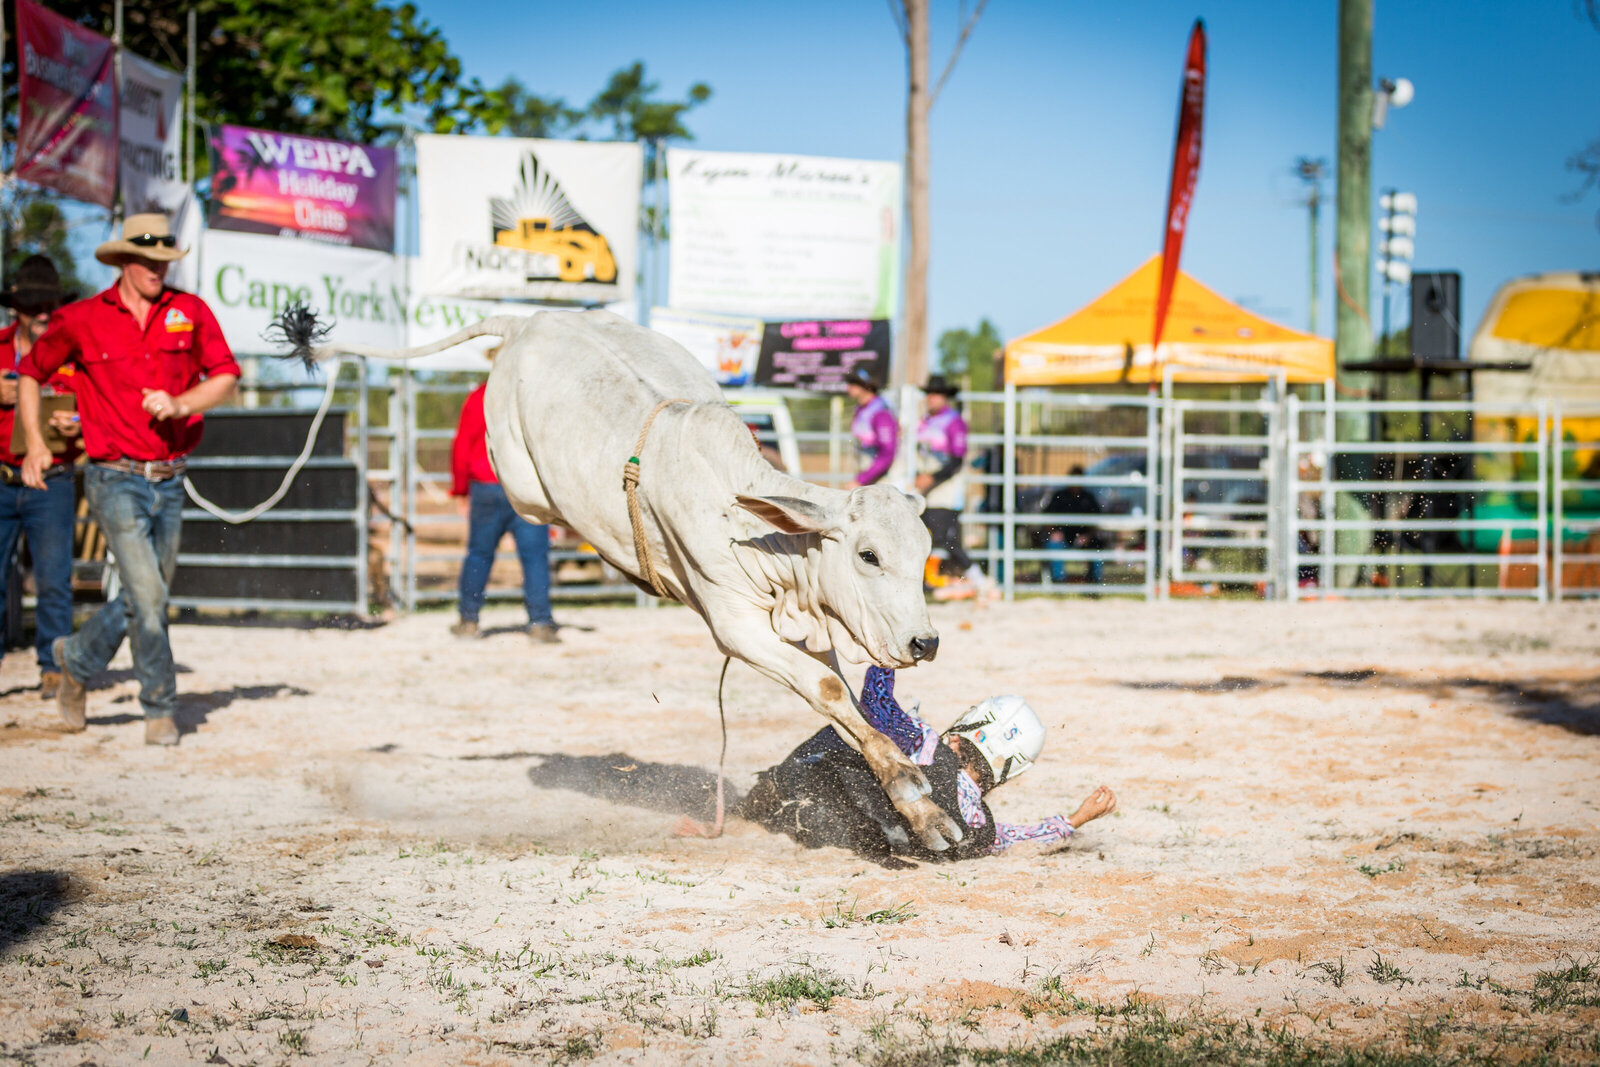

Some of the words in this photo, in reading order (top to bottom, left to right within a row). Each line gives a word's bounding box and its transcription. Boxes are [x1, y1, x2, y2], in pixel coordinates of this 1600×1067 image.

[247, 131, 376, 178] WEIPA
[278, 168, 358, 207] Holiday
[294, 198, 348, 232] Units
[215, 264, 311, 319] Cape
[322, 276, 386, 324] York
